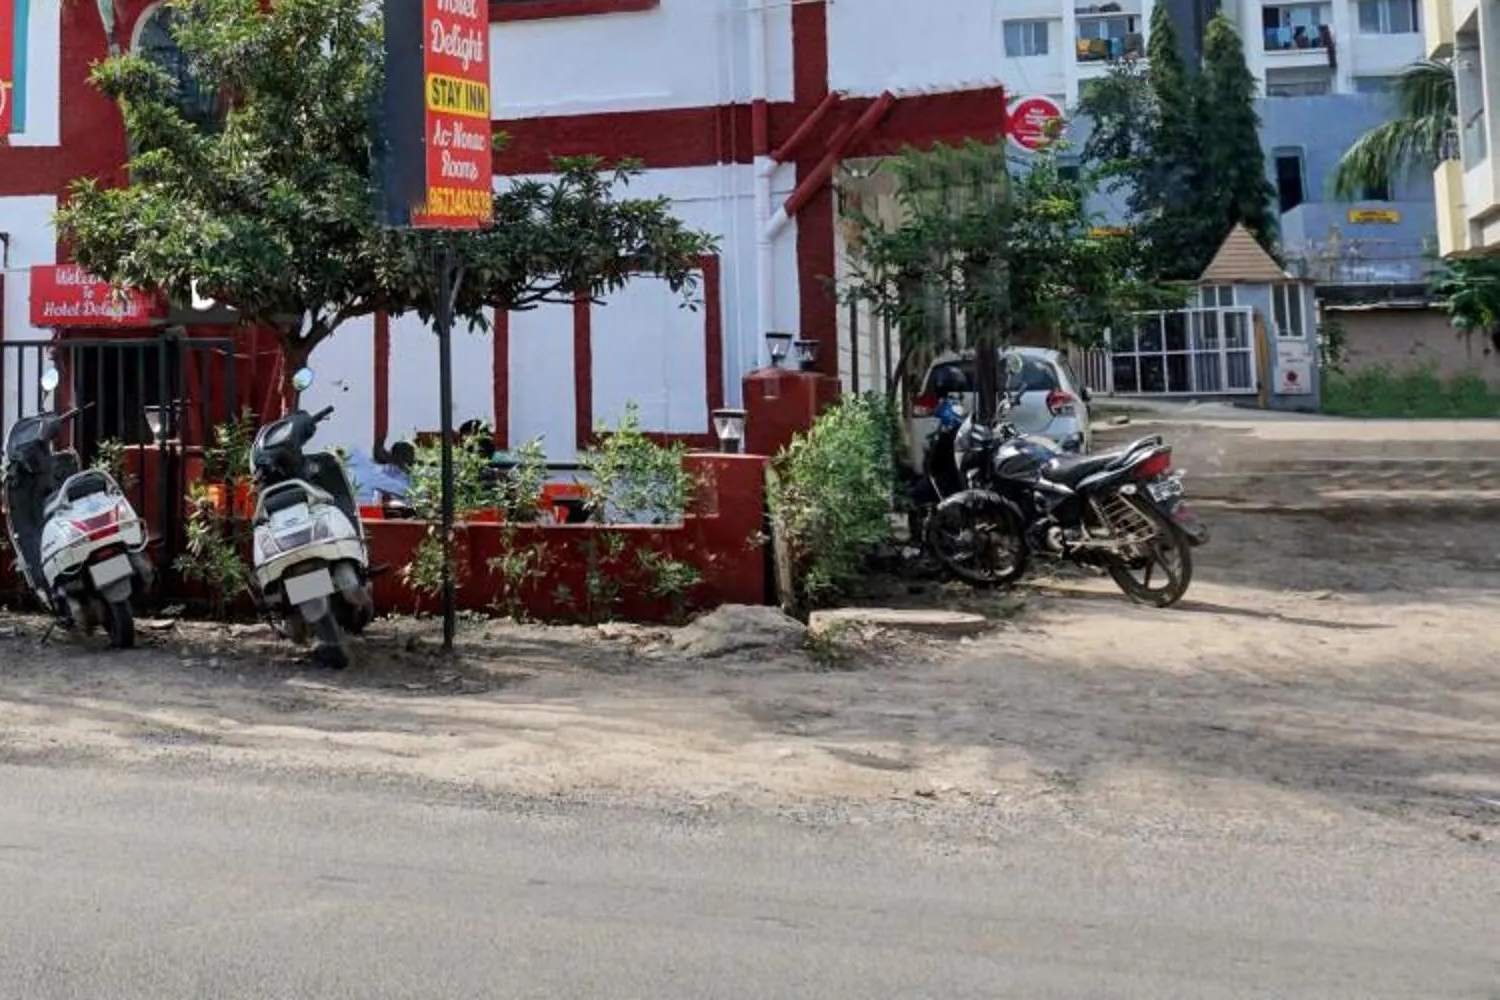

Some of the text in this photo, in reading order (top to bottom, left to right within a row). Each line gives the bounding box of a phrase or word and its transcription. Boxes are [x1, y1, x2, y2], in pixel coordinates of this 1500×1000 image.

[431, 18, 485, 72] Delight
[431, 77, 485, 113] STAY INN
[441, 149, 479, 181] Rooms
[43, 300, 80, 317] Hotel
